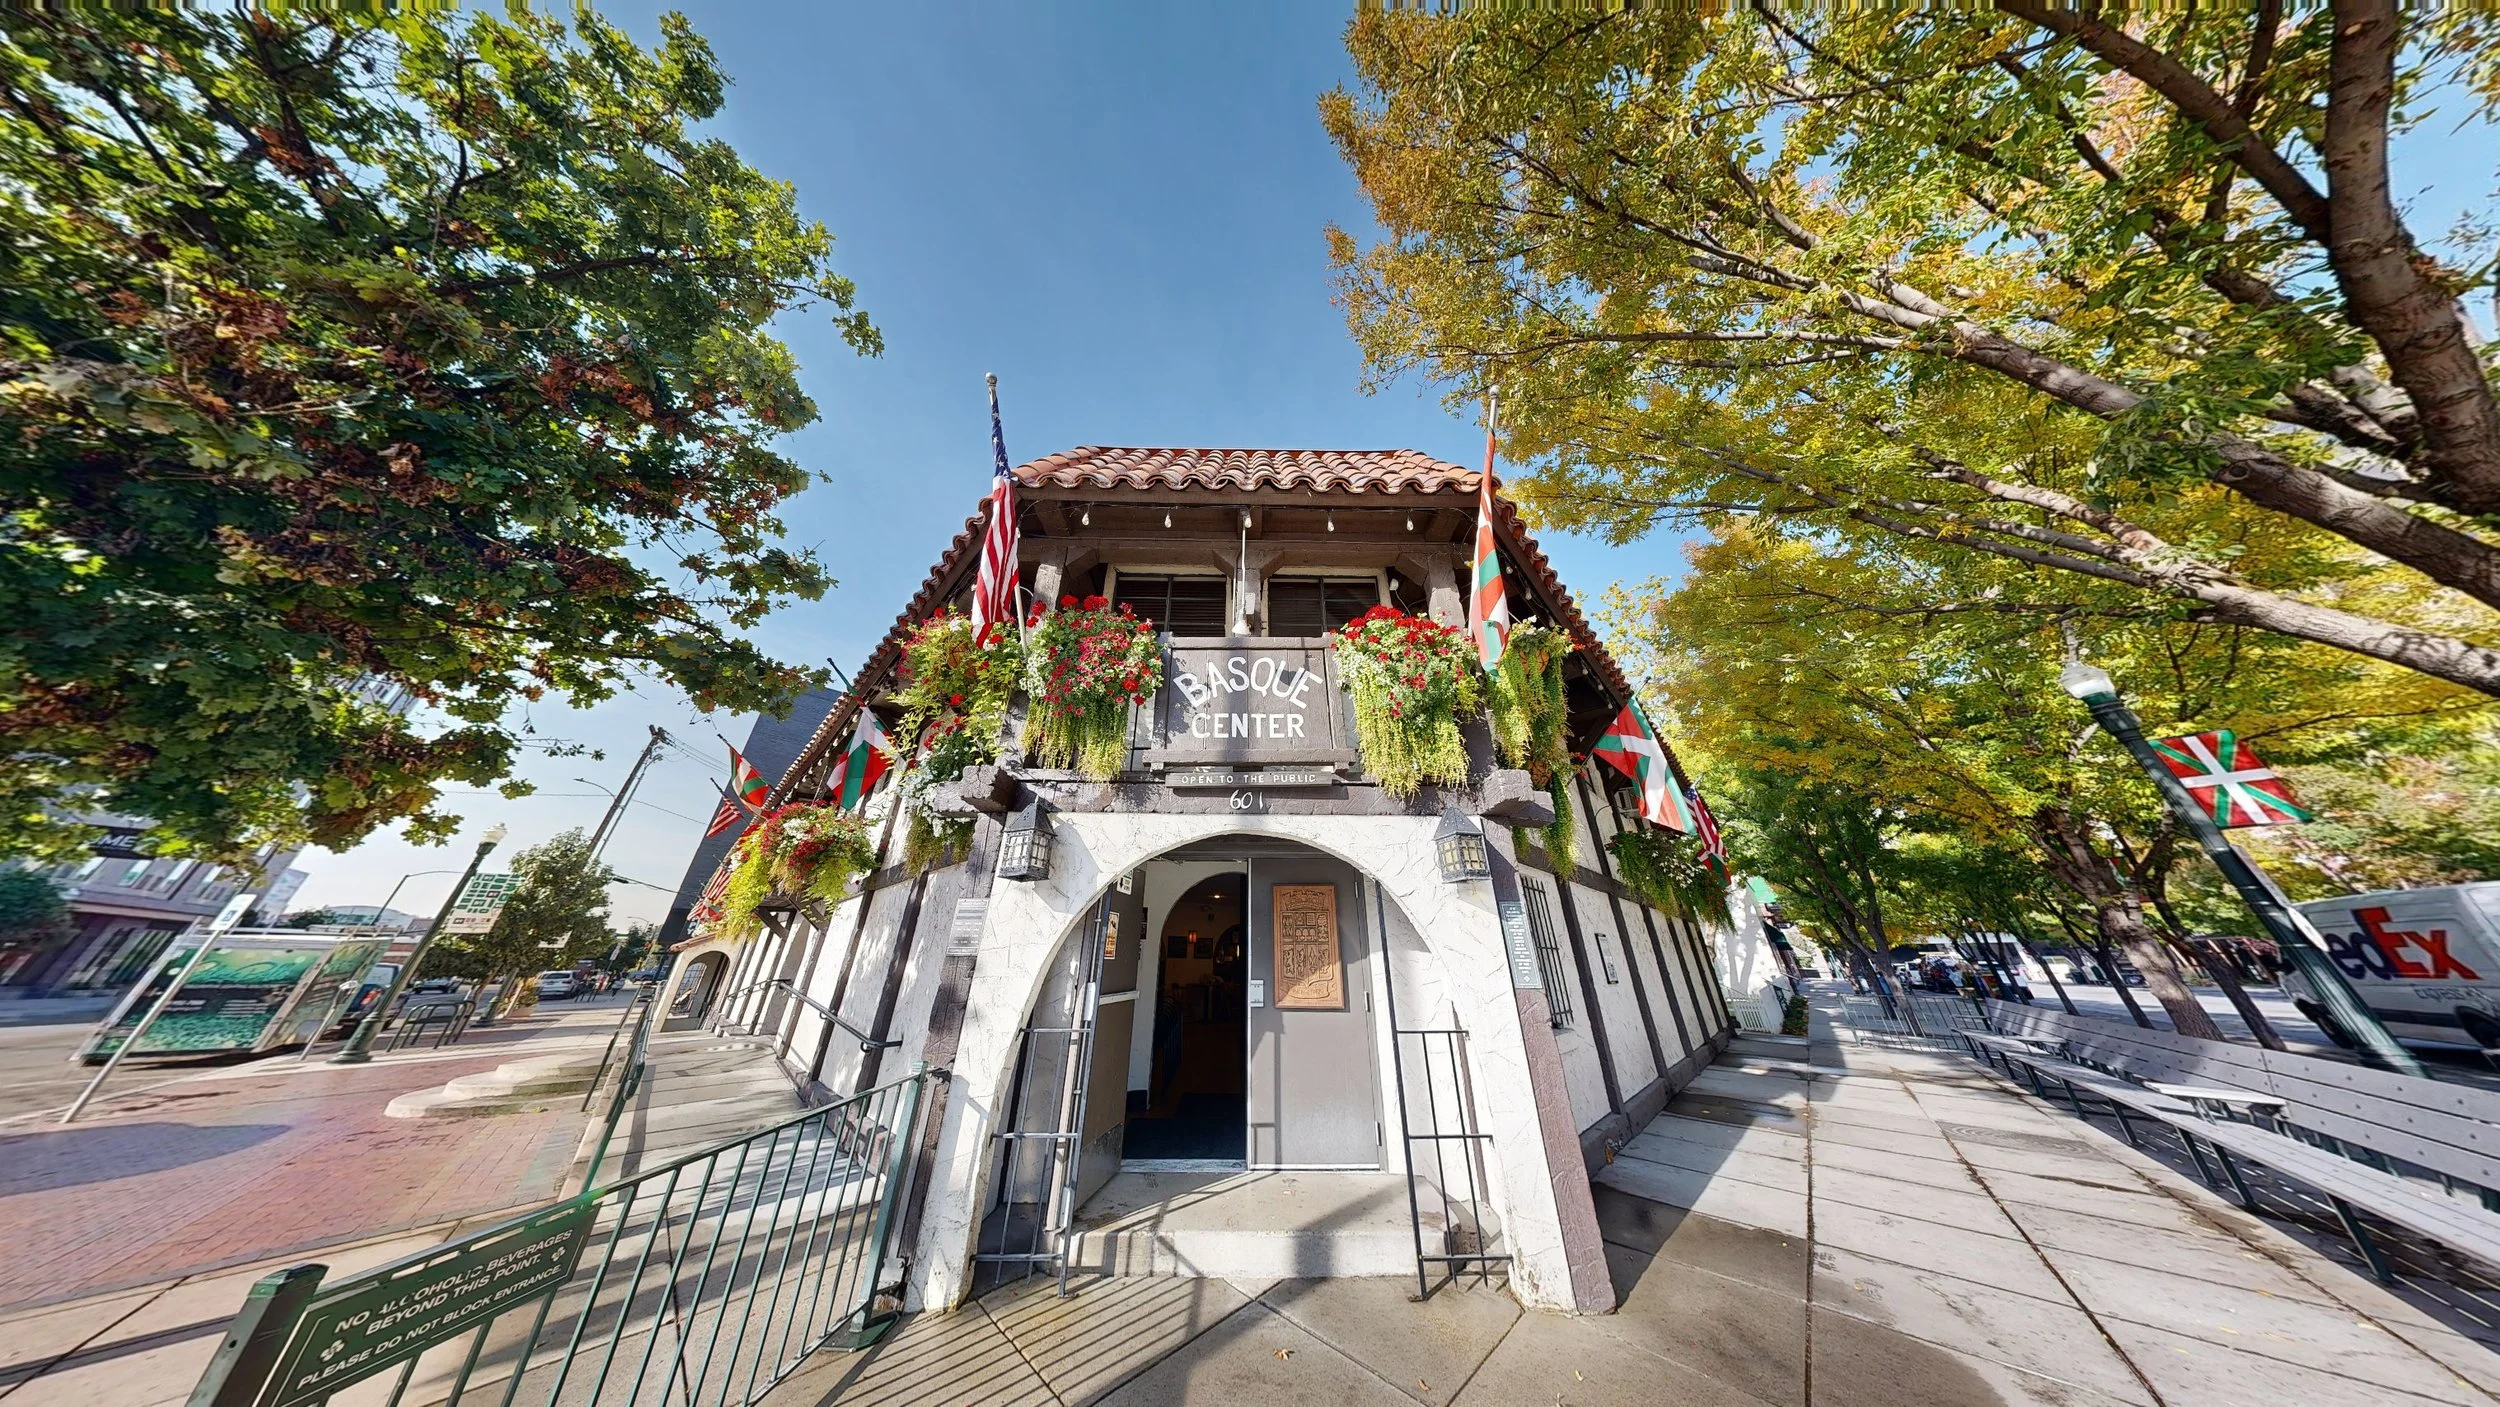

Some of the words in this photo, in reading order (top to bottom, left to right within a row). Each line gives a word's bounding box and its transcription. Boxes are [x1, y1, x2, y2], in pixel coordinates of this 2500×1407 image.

[1173, 656, 1323, 709] BASQUE
[1191, 712, 1306, 739] CENTER
[1181, 775, 1213, 784] OPEN
[1219, 775, 1234, 784] TO
[1243, 774, 1265, 783] THE
[1273, 774, 1317, 783] PUBLIC
[1229, 789, 1264, 810] 601
[2324, 906, 2484, 980] edEx
[334, 1311, 371, 1334] NO
[379, 1265, 484, 1315] ALCOHOLIC
[486, 1229, 573, 1273] BEVERAGES
[365, 1293, 447, 1336] BEYOND
[452, 1275, 491, 1299] THIS
[493, 1254, 542, 1281] POINT.
[296, 1348, 373, 1390] PLEASE
[374, 1335, 401, 1355] DO
[404, 1317, 442, 1342] NOT
[442, 1295, 493, 1324] BLOCK
